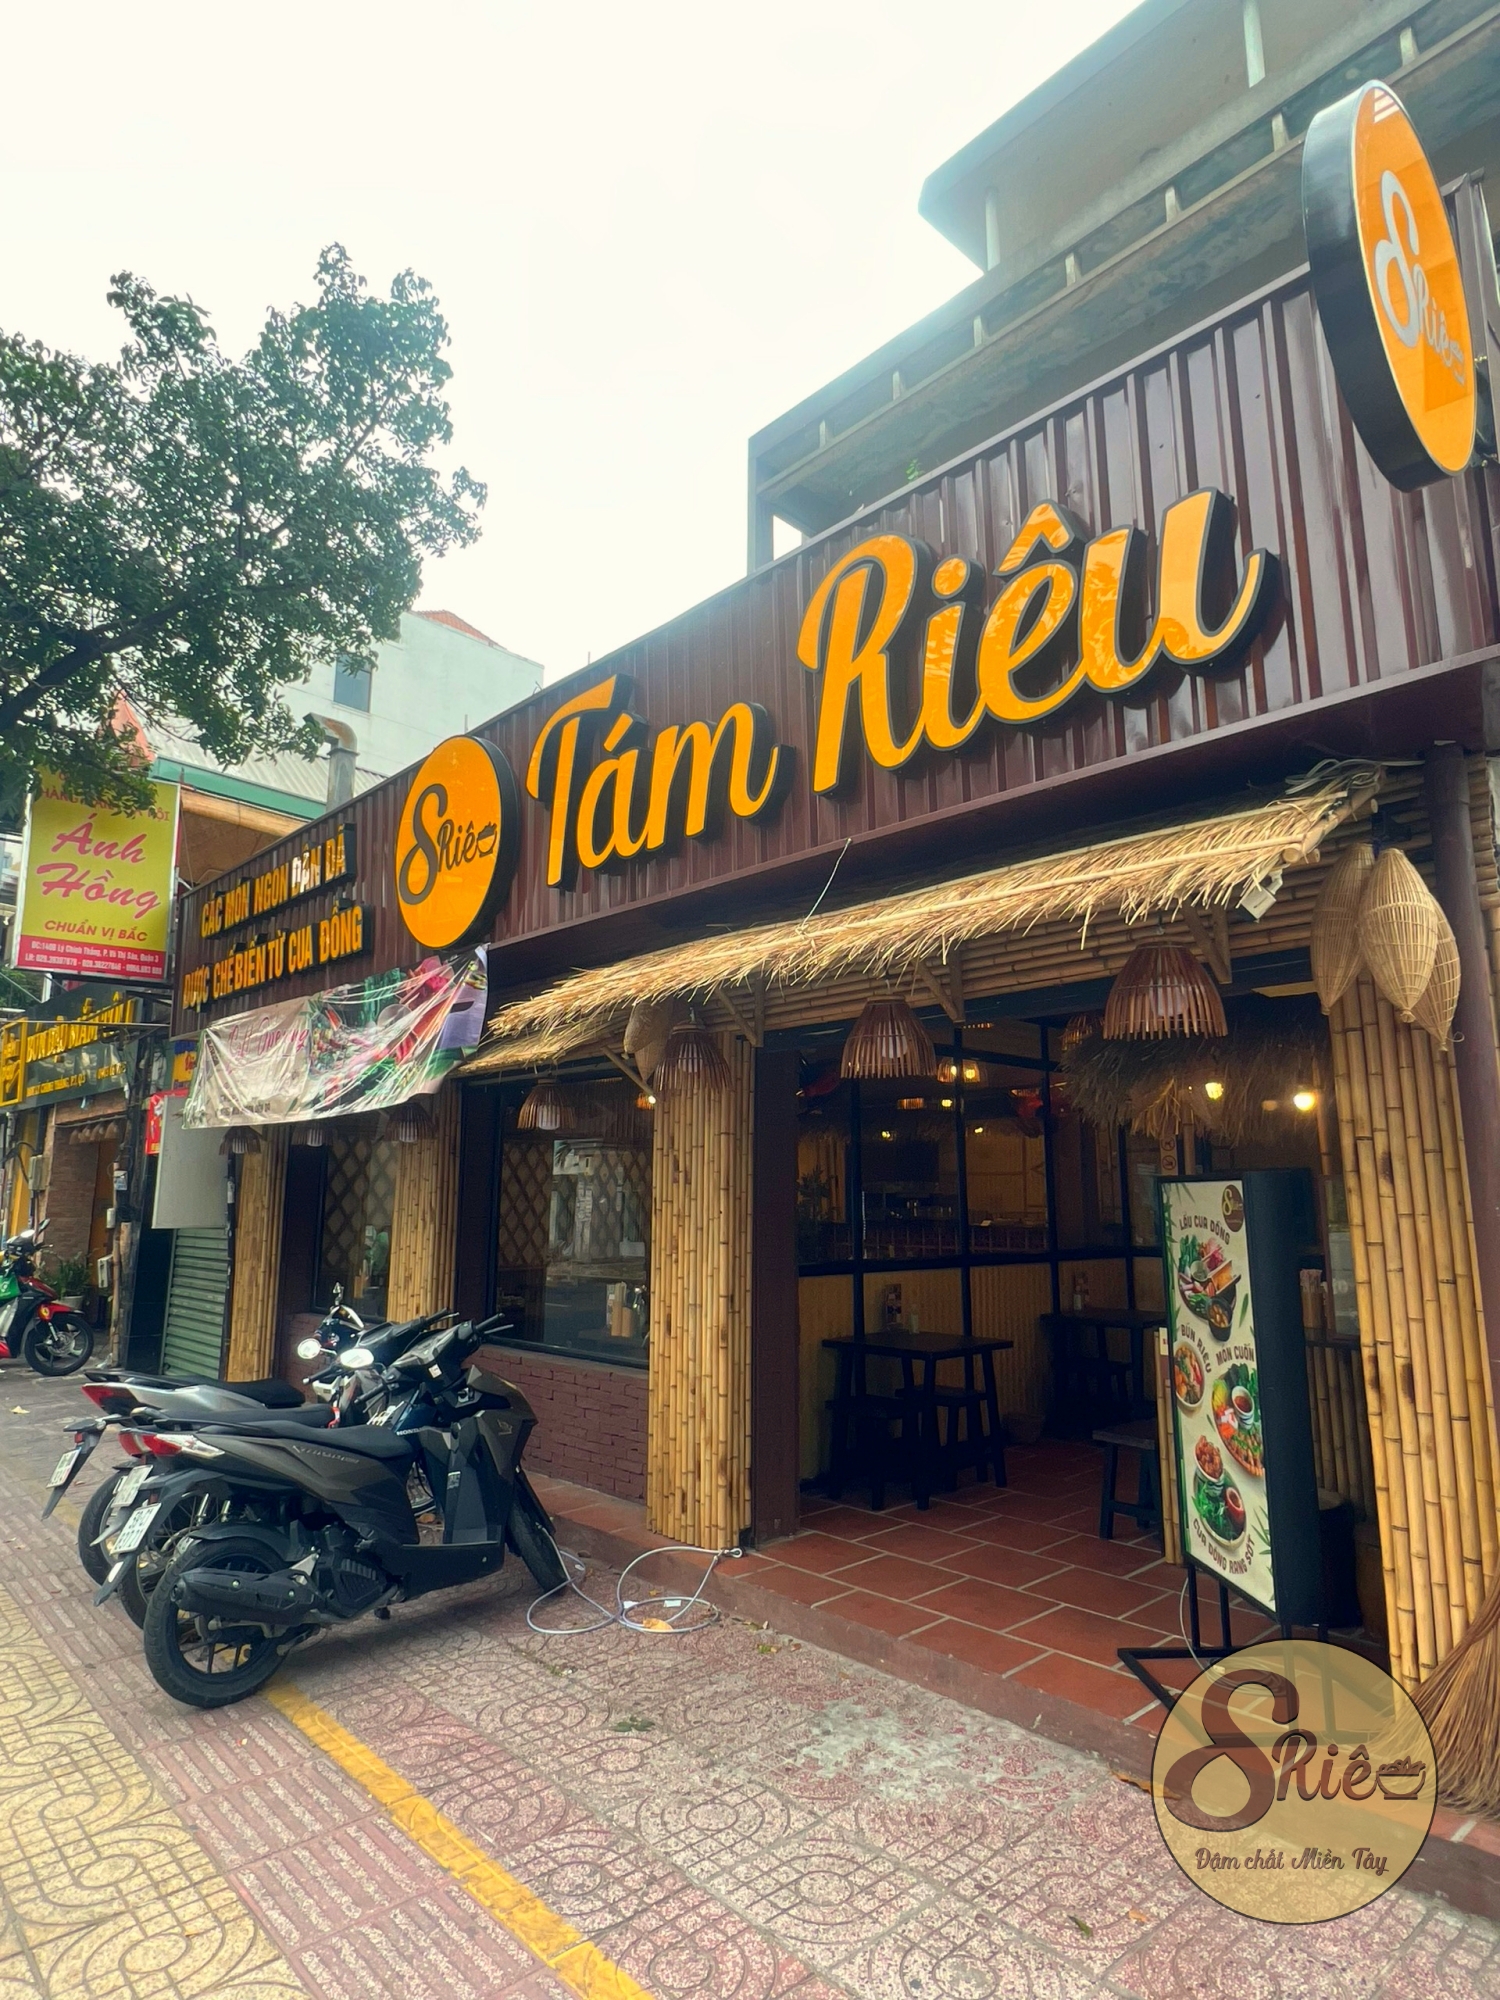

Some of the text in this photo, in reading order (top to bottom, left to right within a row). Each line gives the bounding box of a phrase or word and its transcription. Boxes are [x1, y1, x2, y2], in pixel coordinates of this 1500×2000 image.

[525, 491, 1262, 888] Tám Riêu
[51, 812, 147, 864] Ánh
[36, 862, 161, 919] Hồng
[201, 891, 223, 939] CÁC
[224, 879, 250, 931] MÓN
[253, 863, 289, 916] NGON
[44, 919, 148, 942] CHUẨN VỊ BẮC
[182, 899, 363, 1013] ĐƯỢC CHẾ BIẾN TỪ CUA ĐỒNG
[1194, 1214, 1208, 1229] CUA
[1181, 1323, 1196, 1341] BÚN
[1229, 1558, 1248, 1575] RANG
